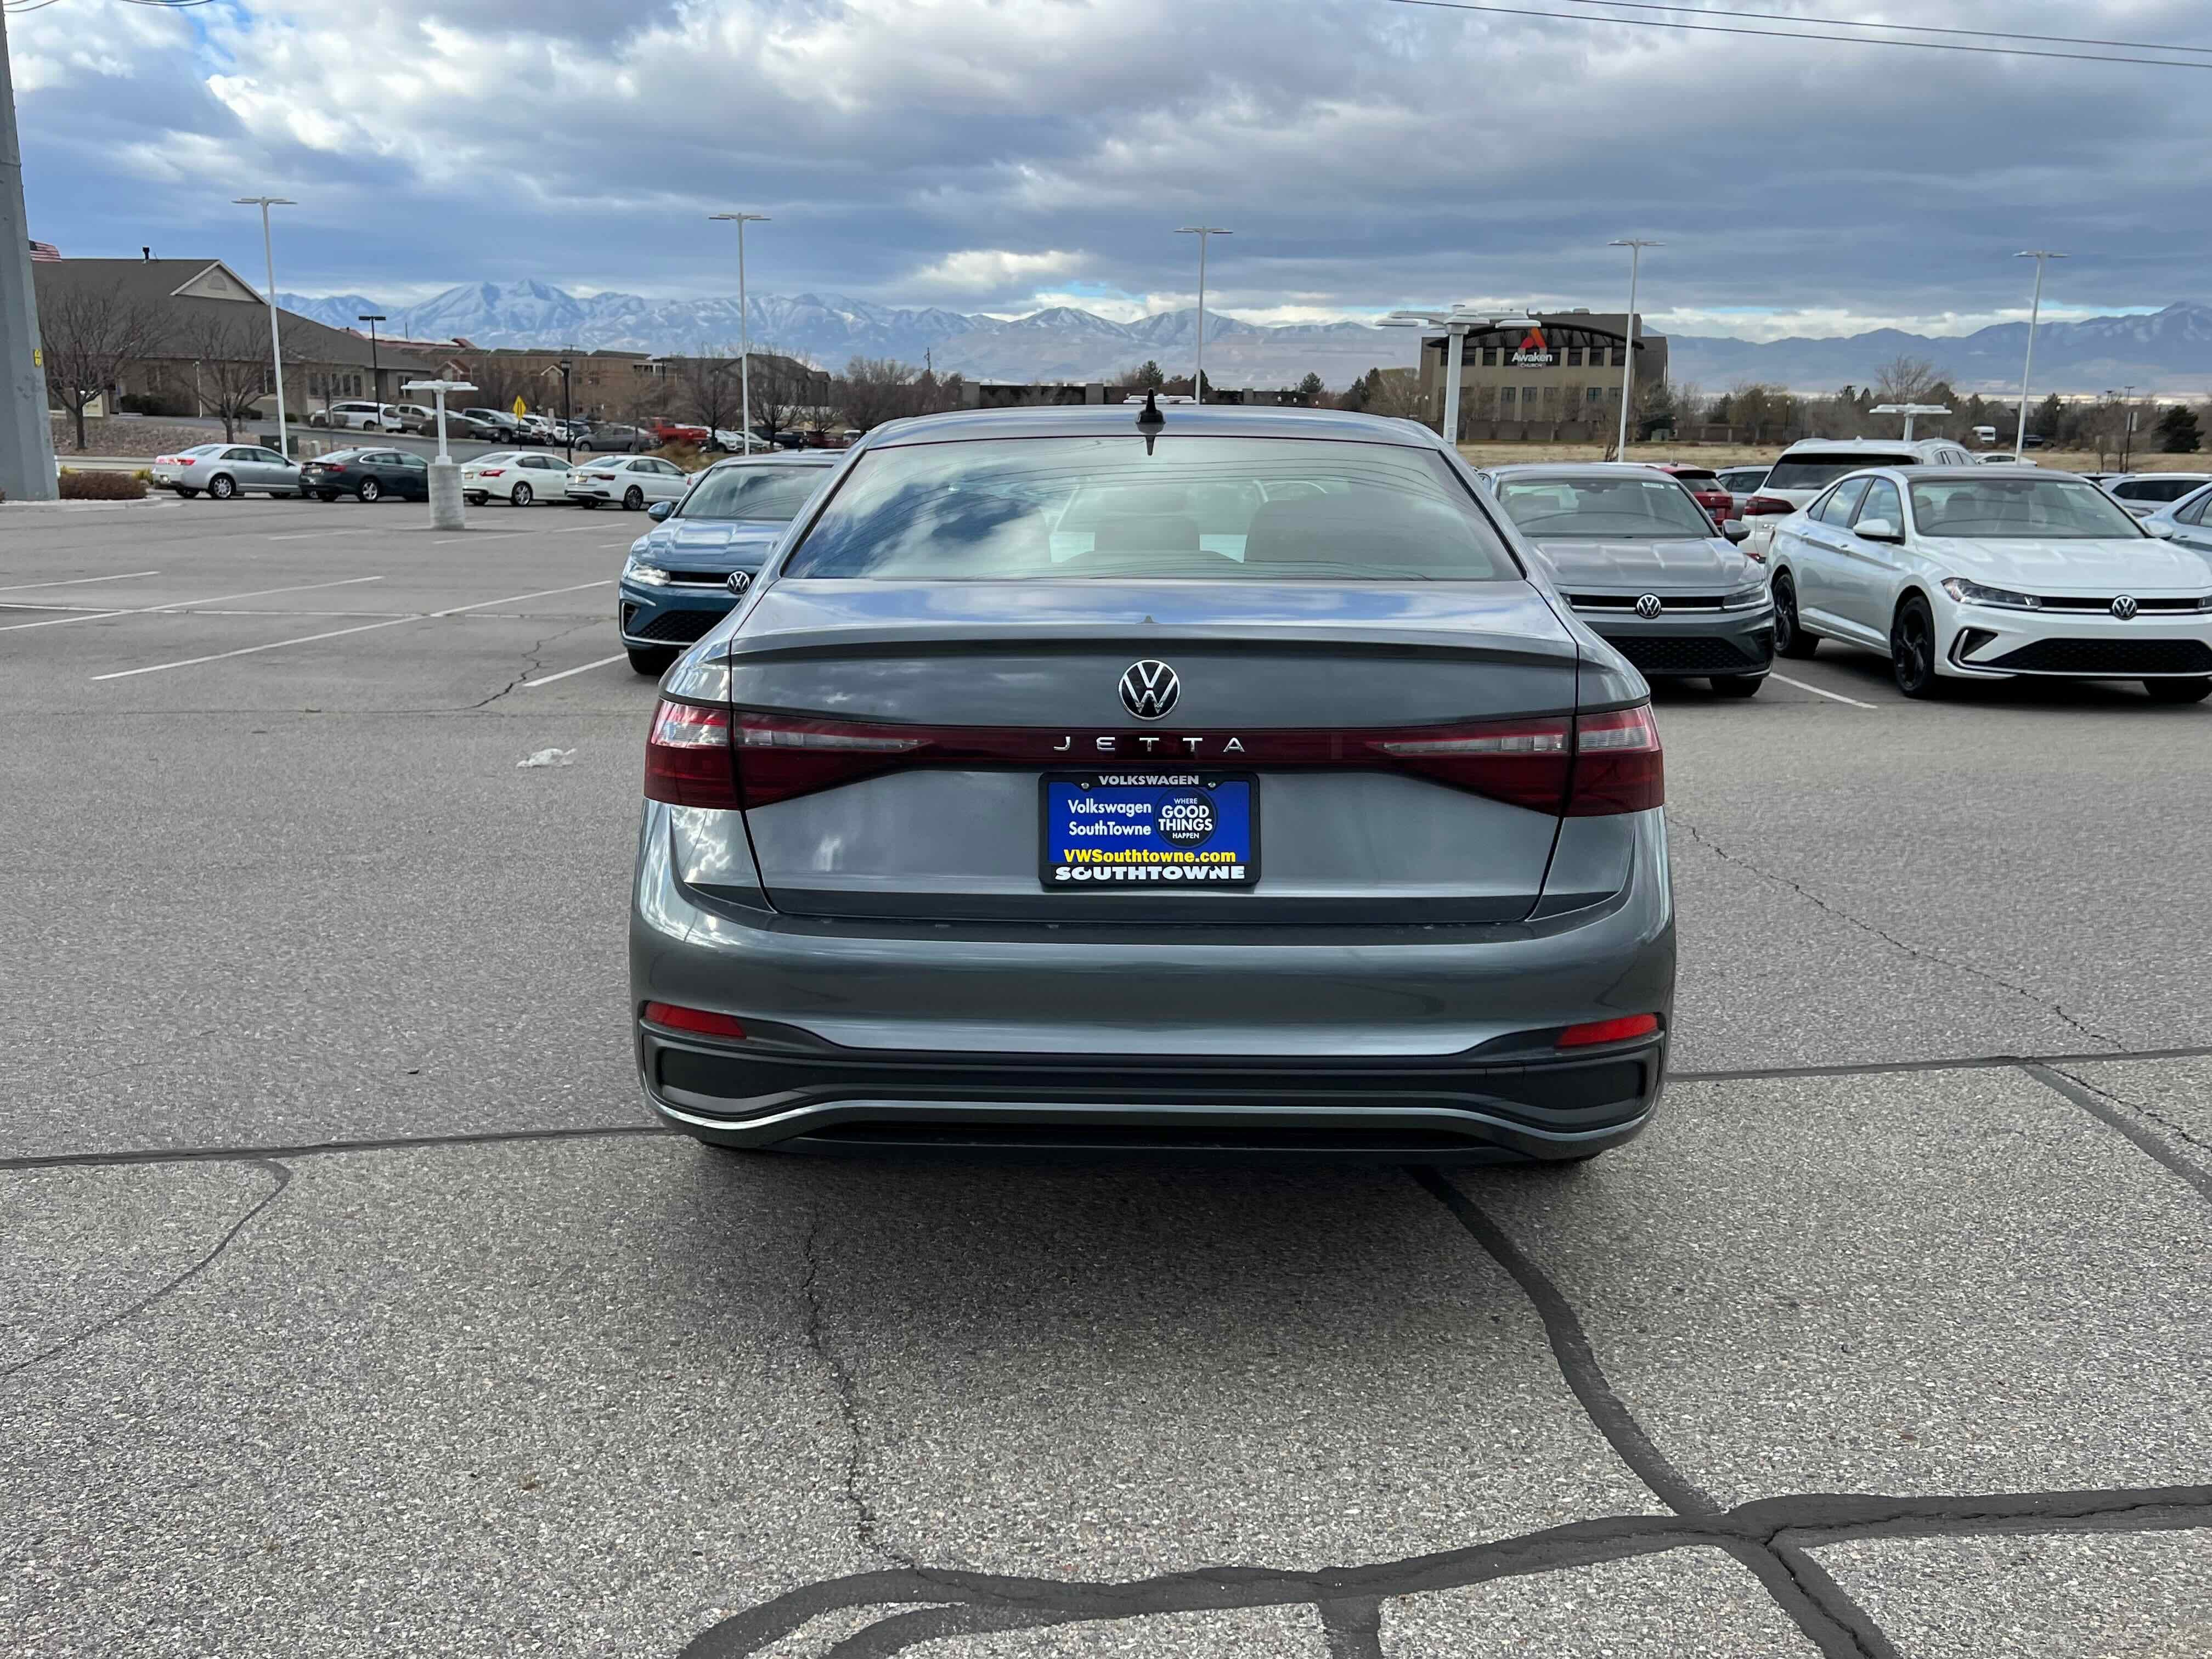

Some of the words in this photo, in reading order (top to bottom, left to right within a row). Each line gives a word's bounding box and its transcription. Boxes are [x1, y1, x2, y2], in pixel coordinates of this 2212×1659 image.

[1511, 352, 1553, 362] Awaken
[1119, 659, 1181, 721] VW
[1053, 736, 1245, 753] JETTA
[1098, 775, 1199, 785] VOLKSWAGEN
[1067, 798, 1152, 817] Volkswagen
[1161, 805, 1210, 819] GOOD
[1069, 821, 1152, 836] SouthTowne
[1158, 818, 1213, 832] THINGS
[1063, 849, 1236, 863] VWSouthtowne.com
[1054, 865, 1245, 881] SOUTHTOWNE
